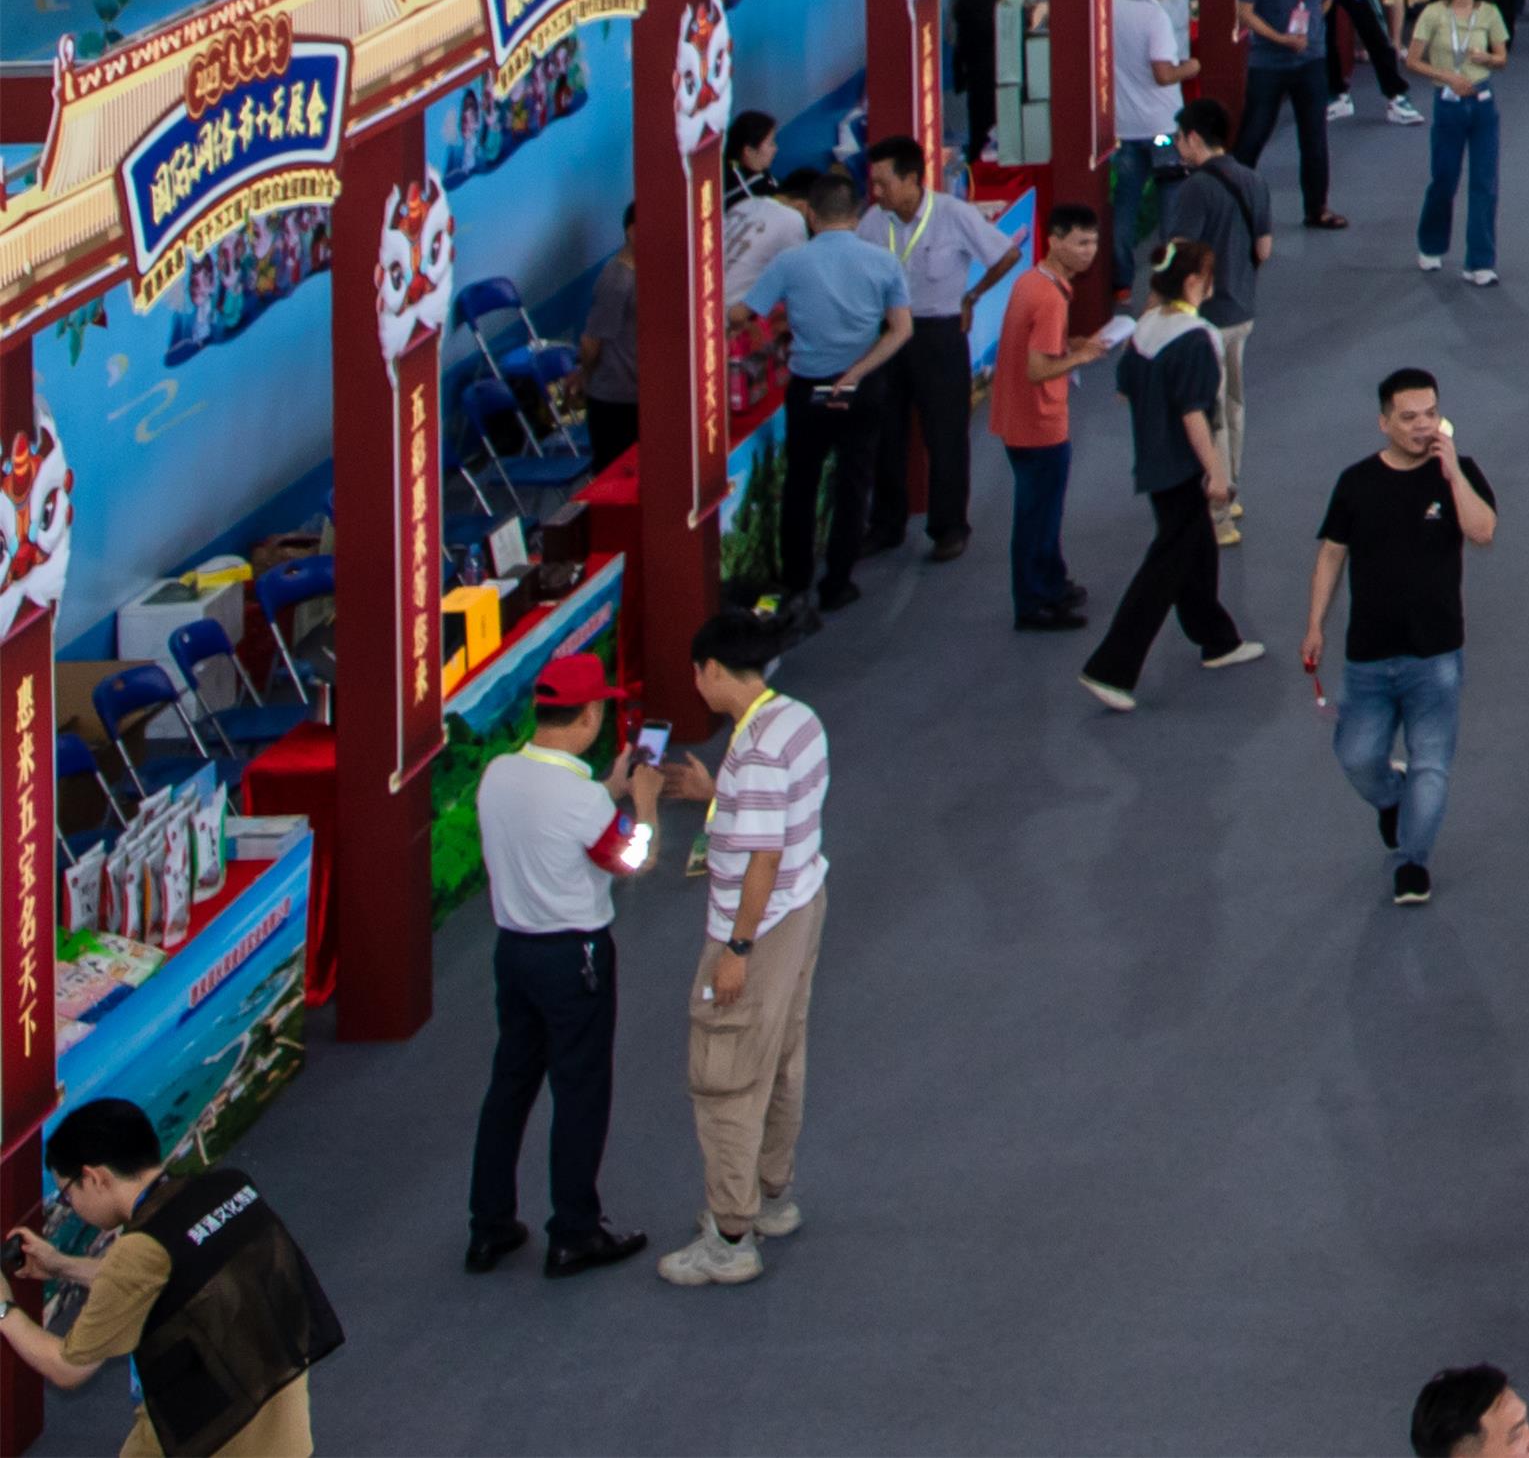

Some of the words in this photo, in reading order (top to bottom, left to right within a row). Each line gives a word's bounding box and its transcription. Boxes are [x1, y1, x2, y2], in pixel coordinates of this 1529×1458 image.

[15, 674, 37, 1057] 惠来五宝名天下
